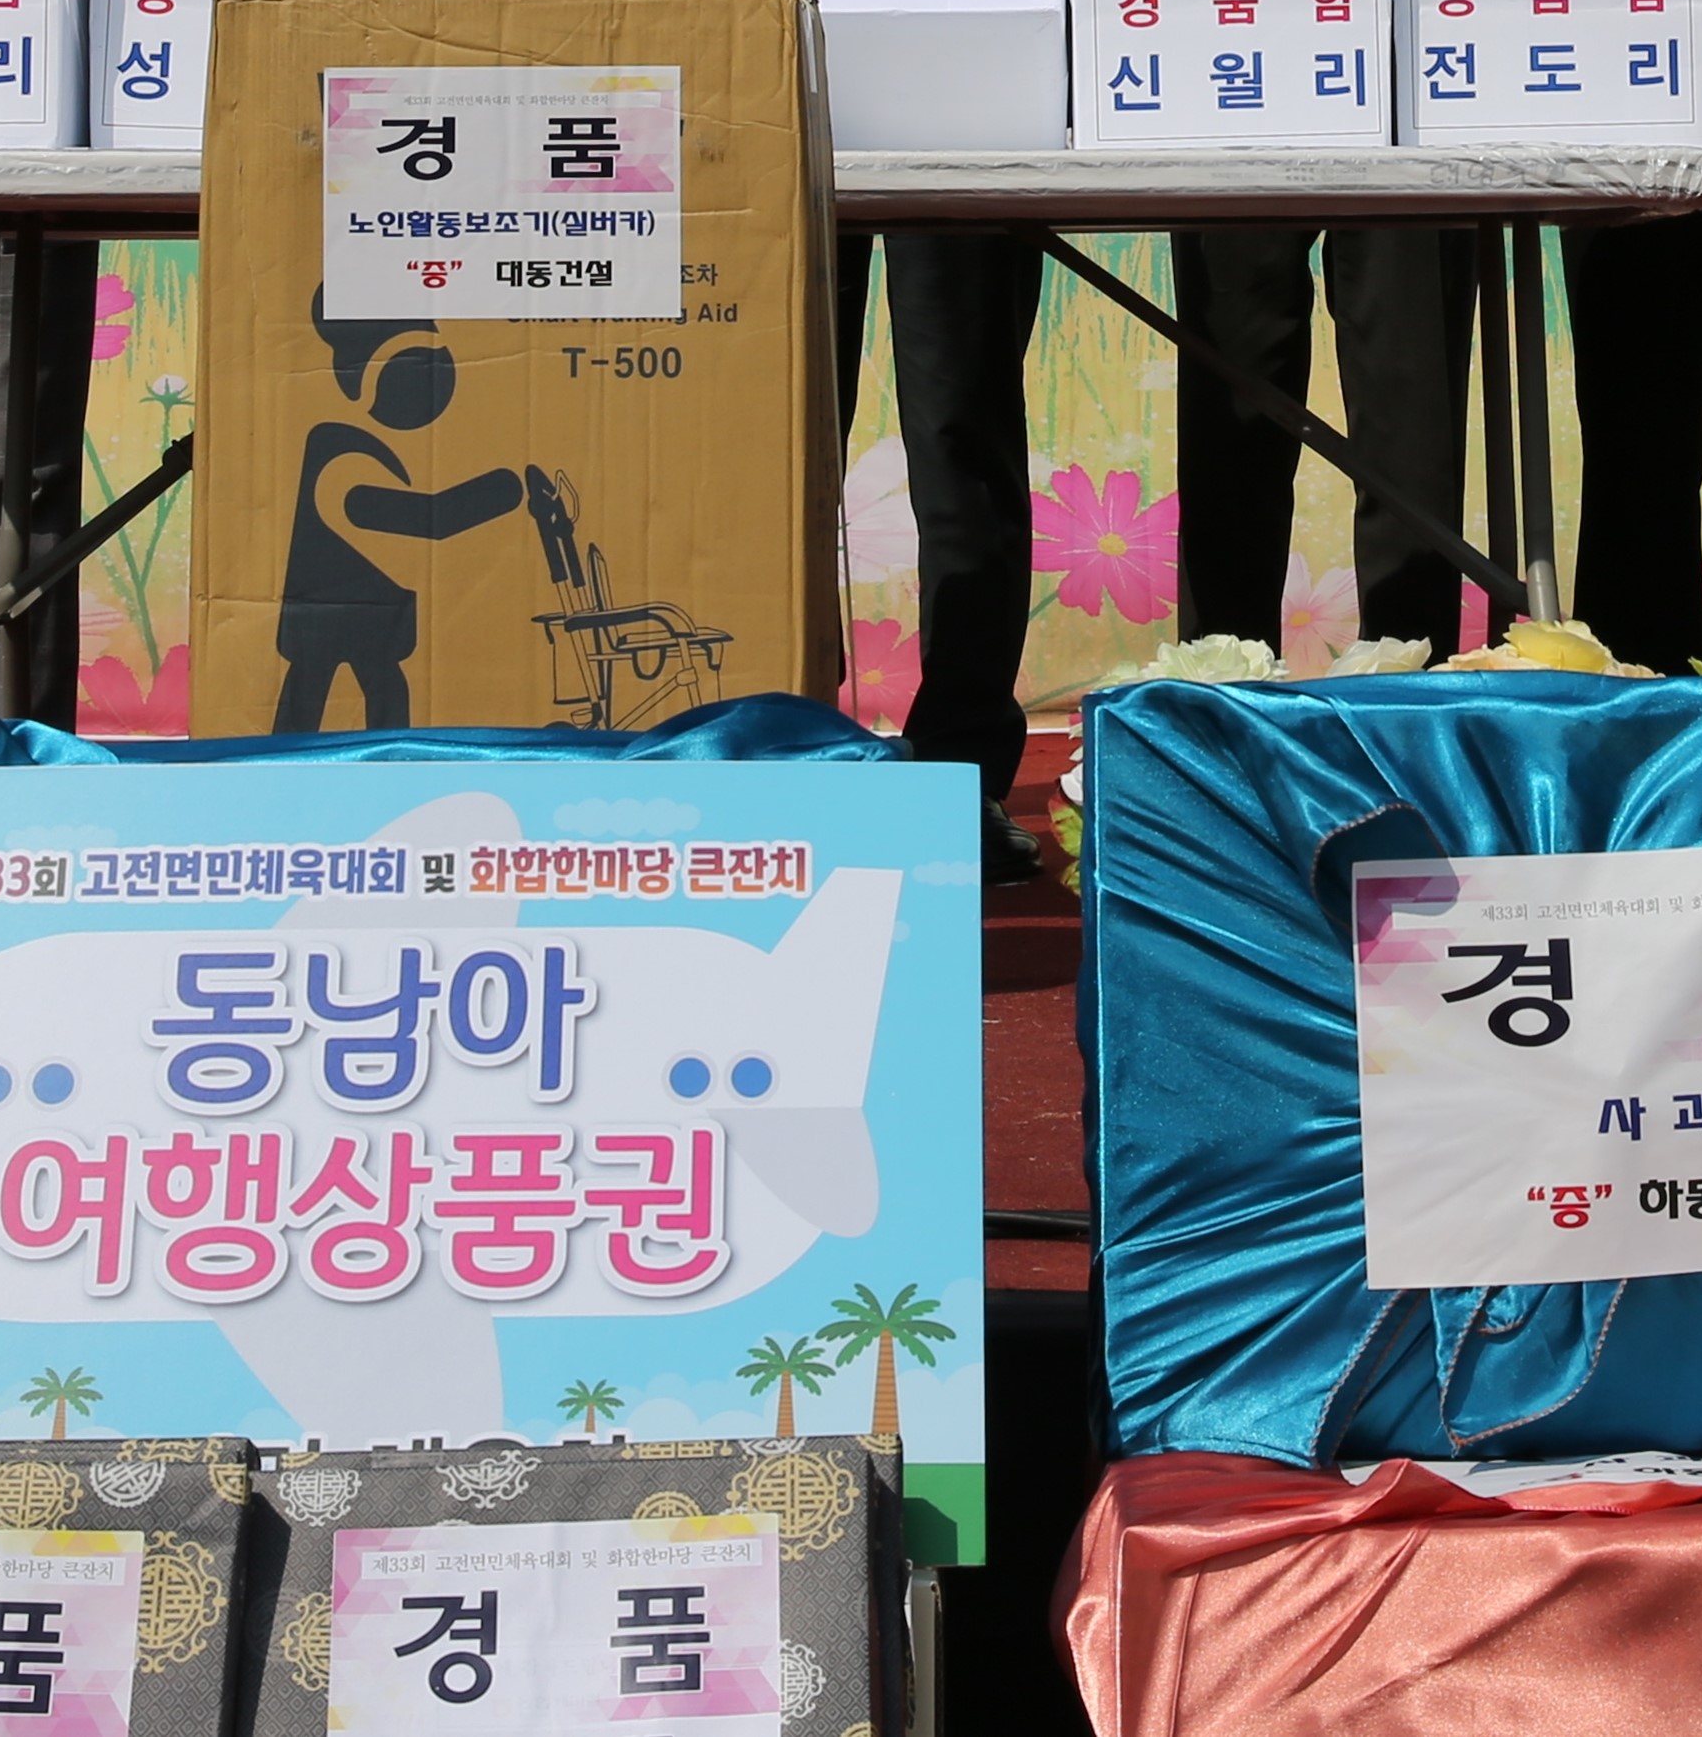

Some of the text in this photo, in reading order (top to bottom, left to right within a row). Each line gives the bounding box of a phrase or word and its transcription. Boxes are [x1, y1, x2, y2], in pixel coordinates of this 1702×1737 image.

[348, 209, 656, 239] 노인활동보조기(실버카)
[496, 260, 613, 288] 대동건설
[698, 303, 738, 322] Aid
[562, 347, 682, 379] T-500
[80, 848, 407, 896] 고전면민체육대회
[423, 852, 455, 894] 및
[470, 847, 673, 894] 화합한마당
[687, 847, 806, 891] 큰잔치
[1481, 903, 1528, 921] 제33회
[1537, 898, 1660, 920] 고전면민체육대회
[1669, 897, 1683, 914] 및
[152, 943, 586, 1106] 동남아
[2, 1129, 723, 1291] 여행상품권
[62, 1560, 114, 1581] 큰잔치
[373, 1543, 751, 1575] 제33회 고전면민체육대회 및 화합한마당 큰잔치
